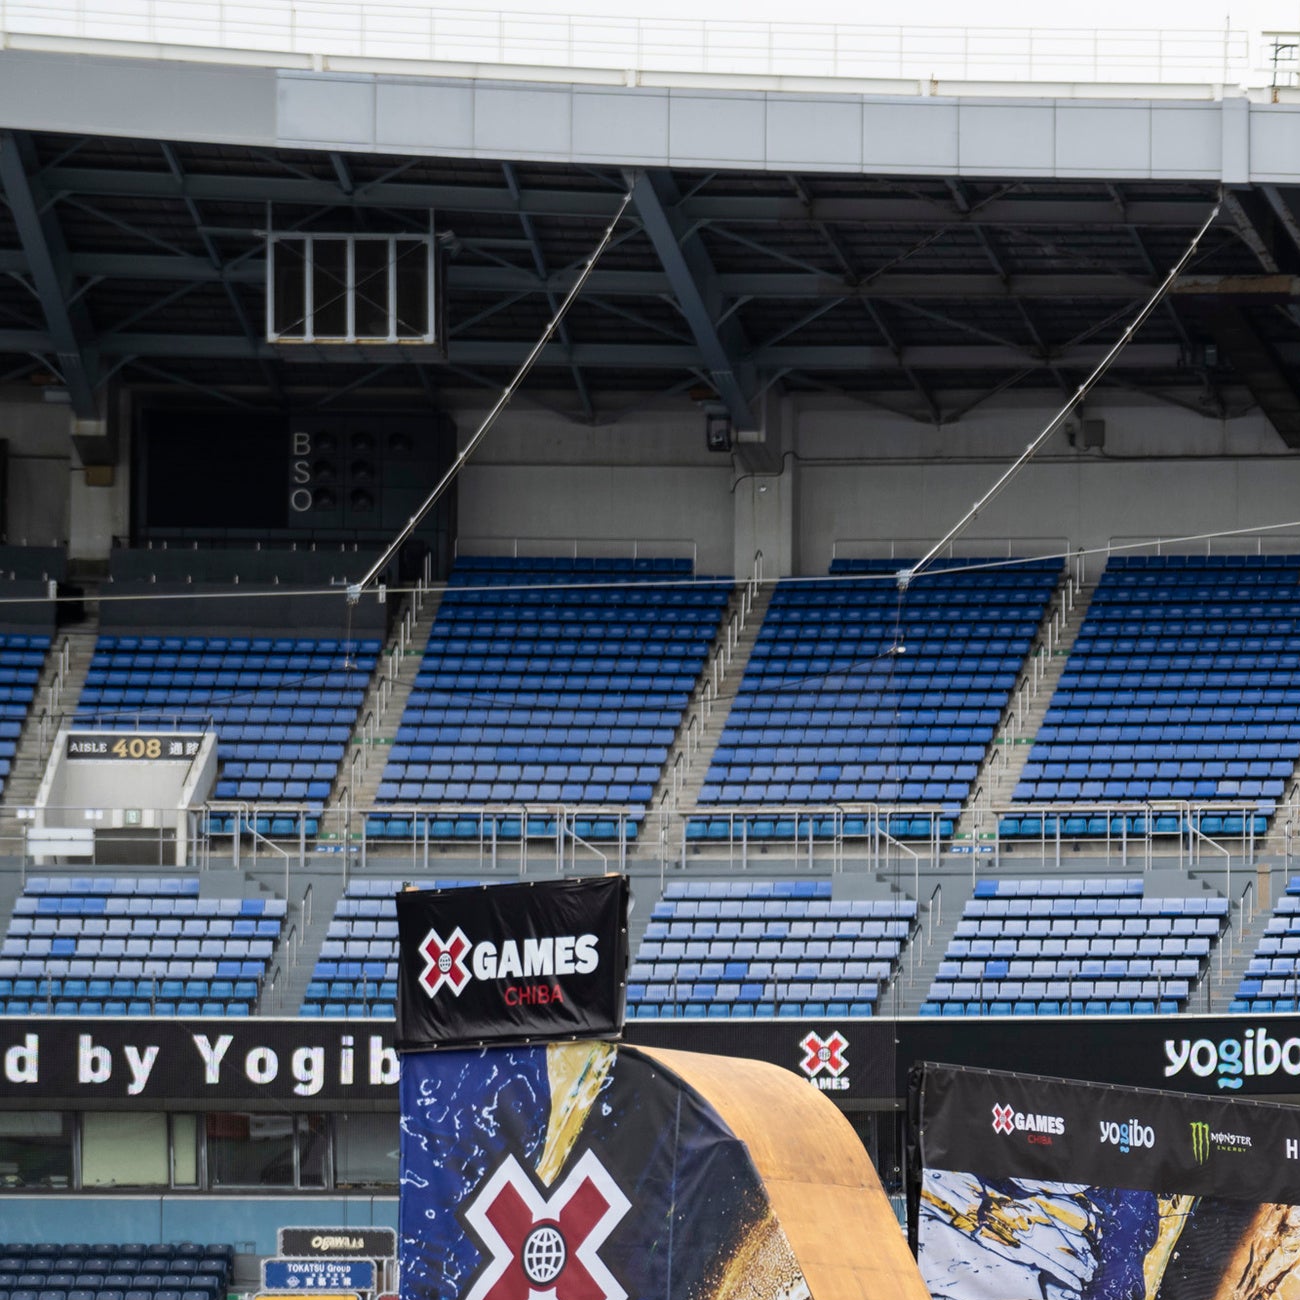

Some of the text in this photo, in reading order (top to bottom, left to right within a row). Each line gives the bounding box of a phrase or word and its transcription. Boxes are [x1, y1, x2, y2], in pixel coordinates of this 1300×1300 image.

[293, 432, 311, 456] B
[294, 461, 311, 484] S
[291, 489, 312, 512] O
[69, 742, 108, 753] AISLE
[112, 738, 162, 759] 408
[473, 934, 599, 981] GAMES
[504, 985, 564, 1006] CHIBA
[78, 1034, 159, 1095] by
[805, 1078, 851, 1090] AMES
[1015, 1112, 1065, 1135] GAMES
[1027, 1134, 1053, 1146] CHIBA
[1100, 1118, 1155, 1154] yogibo
[1216, 1145, 1247, 1153] ENERGY
[287, 1263, 351, 1274] TOKATSU Group
